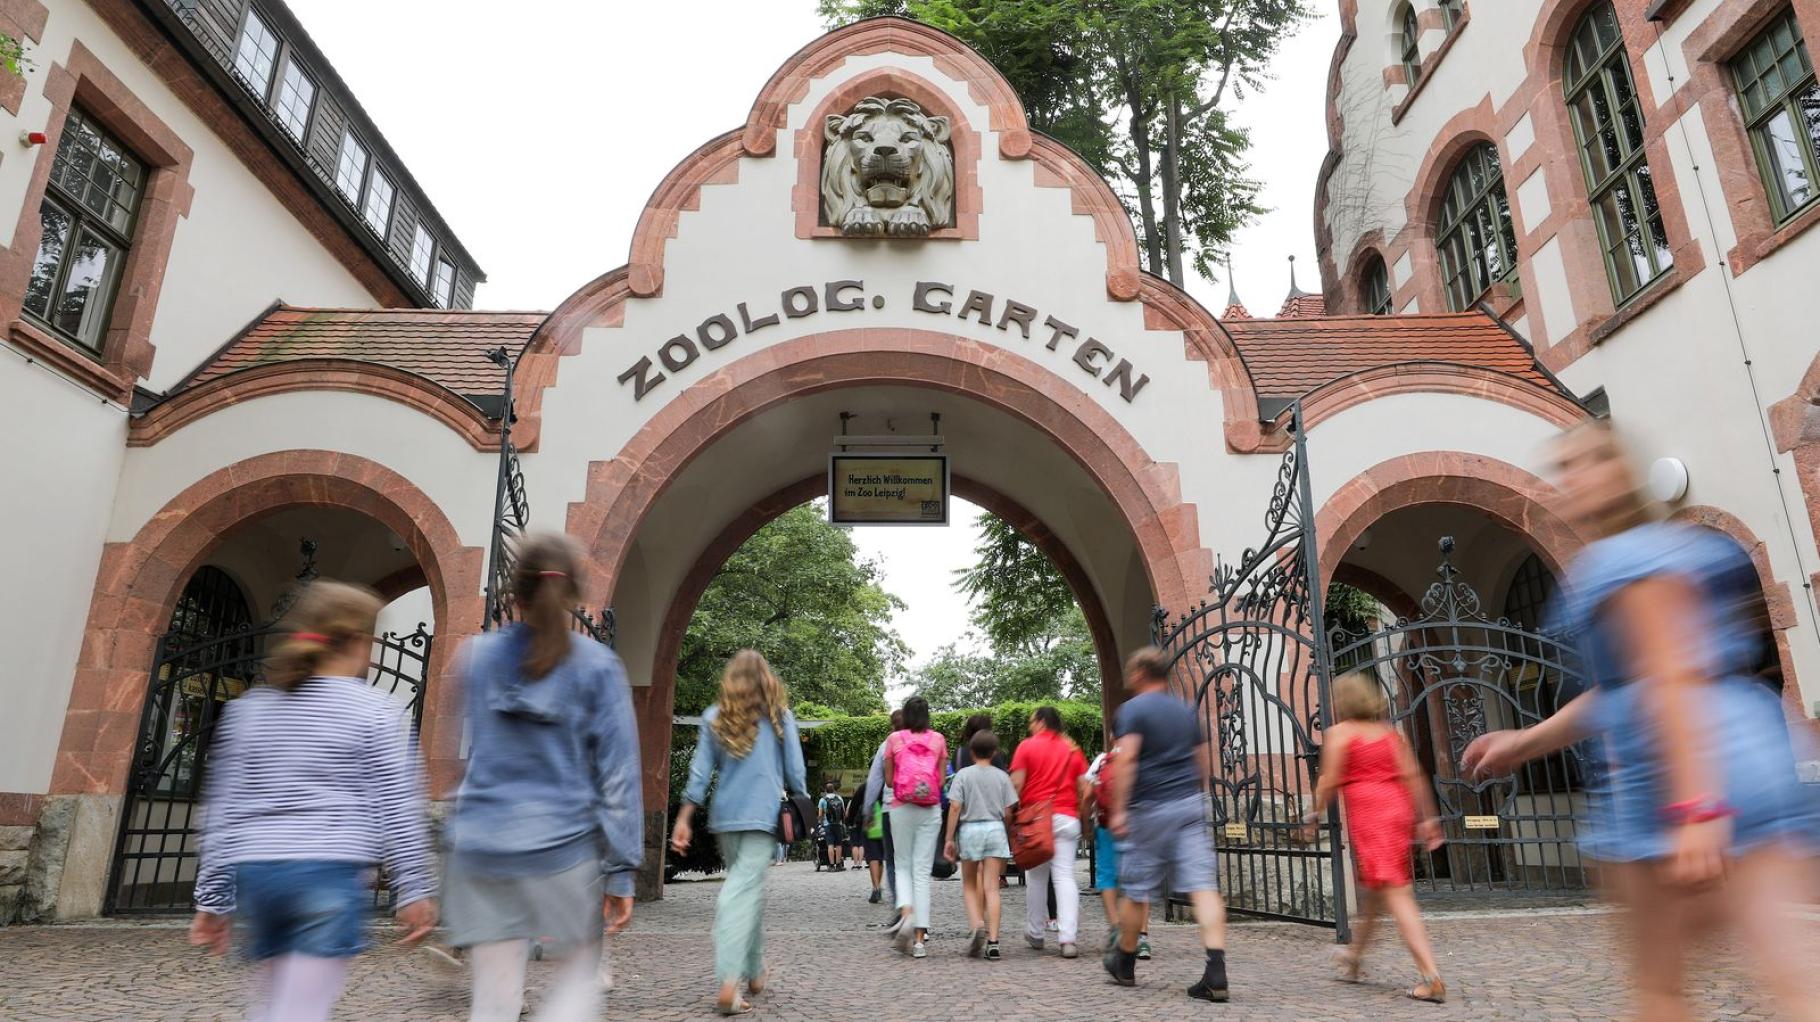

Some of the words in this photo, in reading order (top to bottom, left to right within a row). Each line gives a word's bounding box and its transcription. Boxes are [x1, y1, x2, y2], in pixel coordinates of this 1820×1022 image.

[617, 280, 885, 402] ZOOLOG.
[912, 281, 1152, 403] GARTEN
[848, 474, 882, 485] Herzlich
[884, 474, 933, 485] Willkommen
[845, 488, 856, 497] im
[857, 487, 873, 497] Zoo
[875, 487, 907, 500] Leipzig!
